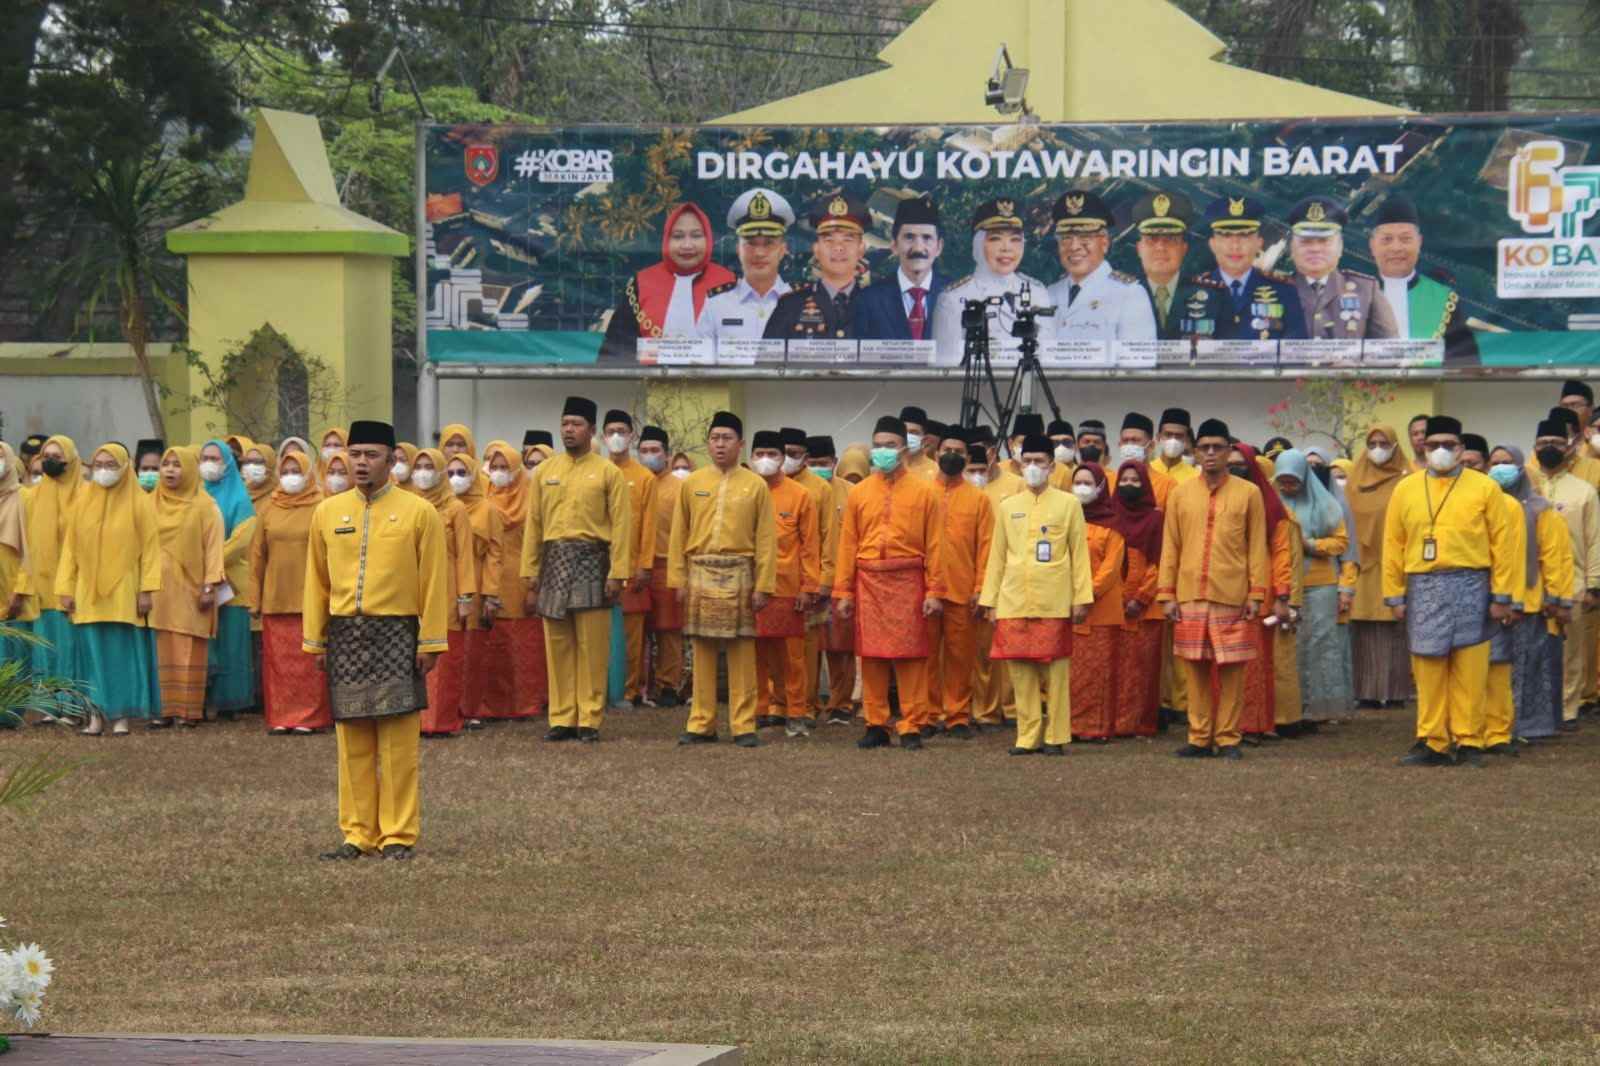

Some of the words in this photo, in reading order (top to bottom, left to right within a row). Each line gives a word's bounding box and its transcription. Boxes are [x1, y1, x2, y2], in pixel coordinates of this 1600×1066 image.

[514, 149, 613, 177] #KOBAR
[697, 151, 924, 180] DIRGAHAYU
[936, 147, 1250, 179] KOTAWARINGIN
[1263, 144, 1404, 176] BARAT
